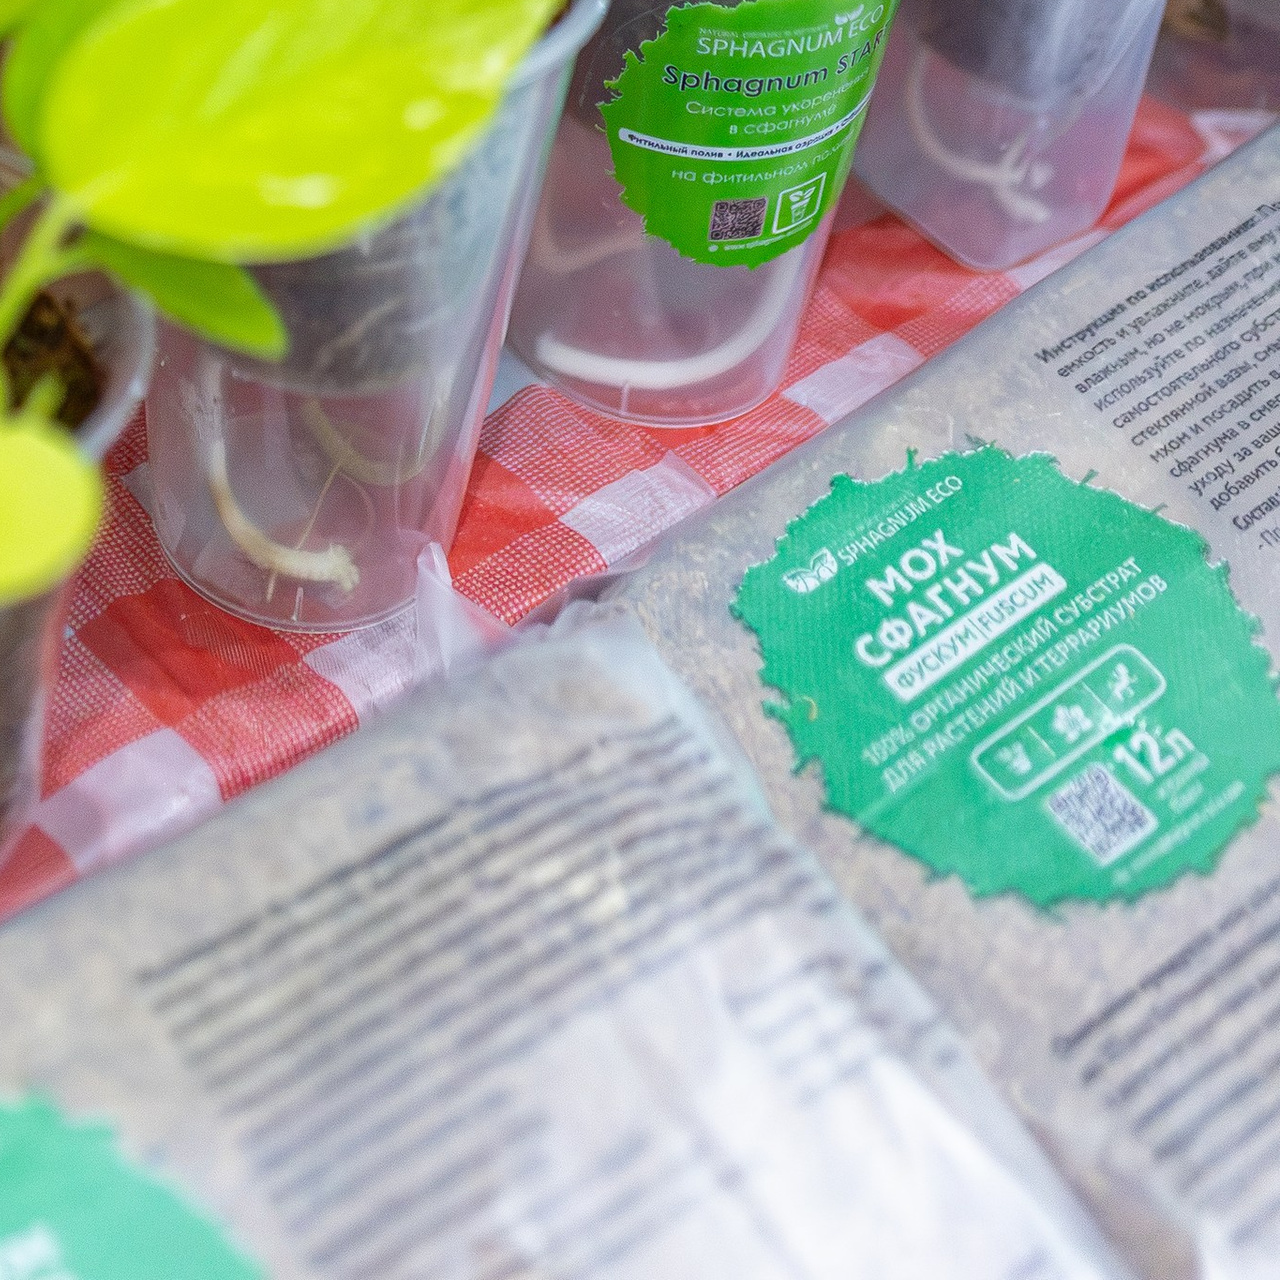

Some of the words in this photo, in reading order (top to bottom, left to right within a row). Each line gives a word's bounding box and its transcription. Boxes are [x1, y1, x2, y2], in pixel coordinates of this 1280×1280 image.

[696, 26, 843, 58] SPHAGNUM
[848, 3, 884, 39] ECO
[662, 64, 828, 98] Sphagnum
[686, 101, 777, 117] Система
[628, 133, 689, 154] Фитильный
[690, 149, 724, 158] полив
[736, 145, 793, 158] Идеальная
[729, 123, 738, 135] в
[744, 103, 837, 135] сфагнуме
[671, 169, 697, 182] на
[702, 160, 808, 186] фитильном
[1034, 303, 1127, 364] Инструкция
[1126, 289, 1148, 306] по
[1057, 337, 1117, 378] емкость
[1075, 347, 1148, 394] влажным,
[1143, 332, 1166, 349] но
[1163, 320, 1186, 336] не
[1093, 347, 1186, 412] используйте
[1183, 335, 1206, 352] по
[1112, 339, 1241, 429] самостоятельного
[1131, 381, 1217, 446] стеклянной
[1214, 361, 1258, 389] вазы,
[1149, 431, 1191, 464] мхом
[1188, 422, 1205, 435] и
[1202, 379, 1271, 426] посадить
[1169, 427, 1240, 478] сфагнума
[1237, 420, 1251, 431] в
[1188, 458, 1236, 497] уходу
[1233, 446, 1254, 462] за
[1209, 458, 1279, 511] добавить
[836, 496, 932, 567] SPHAGNUM
[925, 474, 963, 504] ECO
[853, 531, 1038, 668] СФАГНУМ
[865, 528, 965, 608] МОХ
[897, 623, 977, 690] ФУСКУМ
[976, 572, 1056, 633] FUSCUM
[910, 614, 1058, 733] ОРГАНИЧЕСКИЙ
[1053, 556, 1142, 626] СУБСТРАТ
[882, 748, 927, 794] ДЛЯ
[923, 674, 1024, 758] РАСТЕНИЙ
[1018, 665, 1043, 691] И
[1035, 573, 1169, 676] ТЕРРАРИУМОВ
[1112, 727, 1196, 786] 12л
